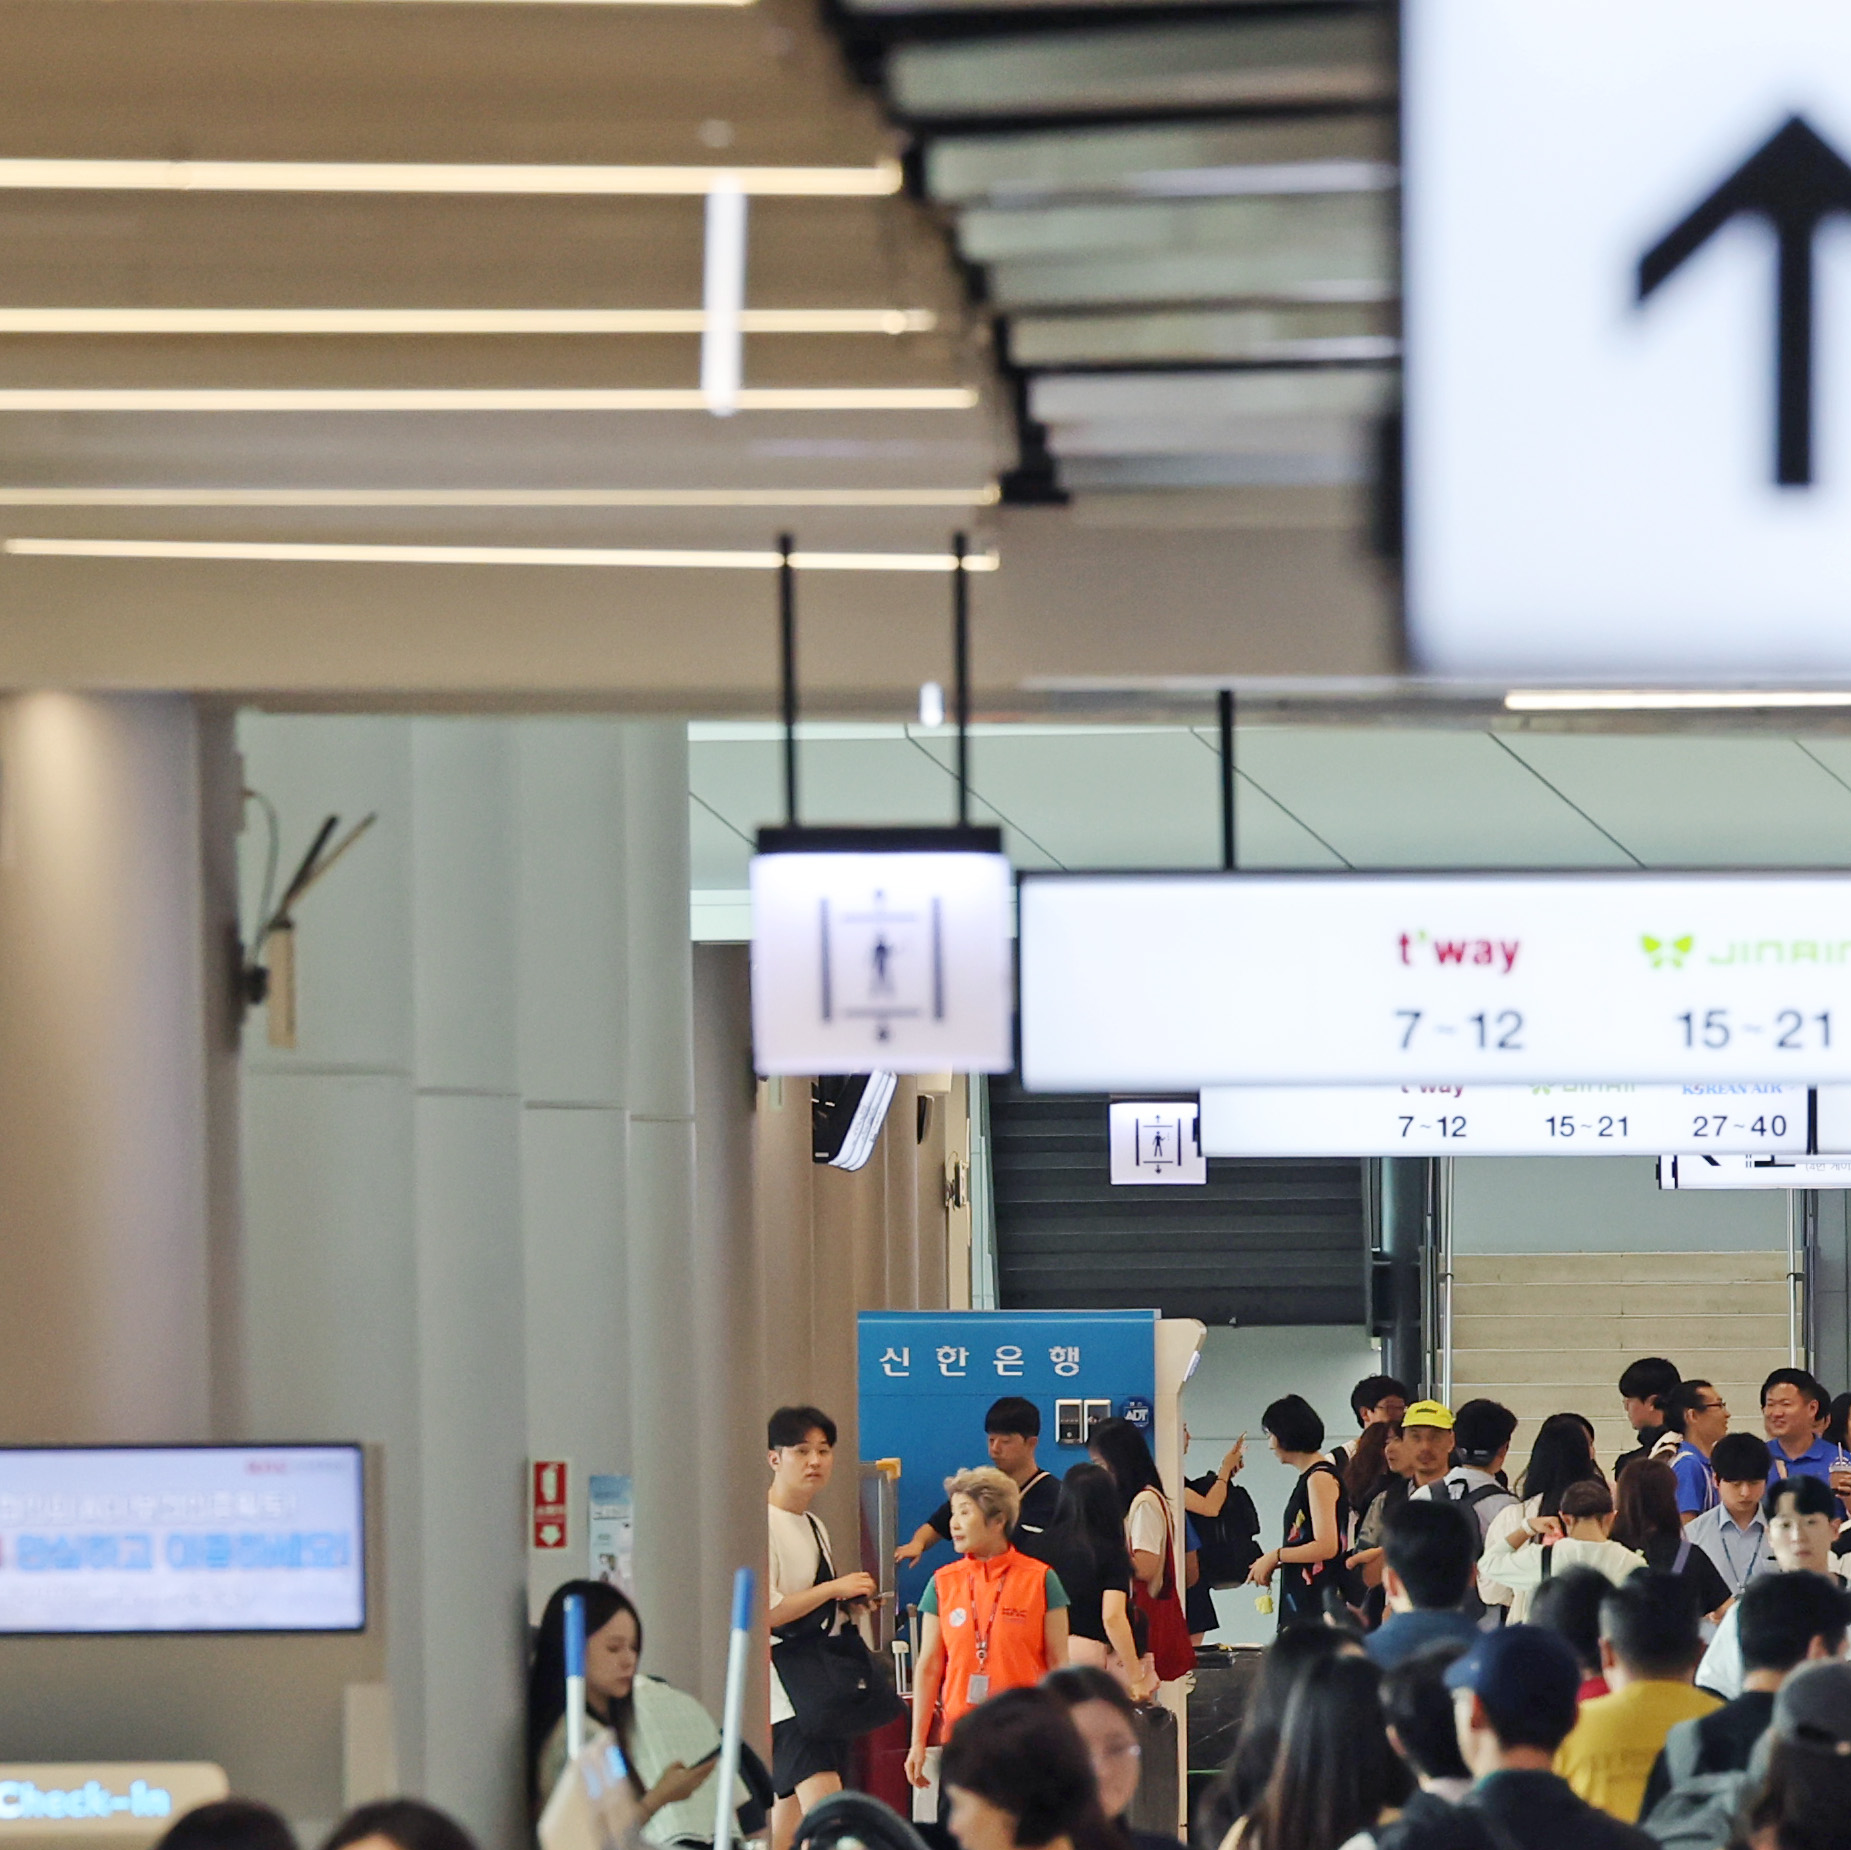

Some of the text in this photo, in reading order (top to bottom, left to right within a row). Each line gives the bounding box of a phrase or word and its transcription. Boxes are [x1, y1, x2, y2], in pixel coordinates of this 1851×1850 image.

[1682, 1082, 1783, 1096] KOREAN AIR
[879, 1345, 1080, 1377] 신한은행
[1124, 1409, 1149, 1421] ADT
